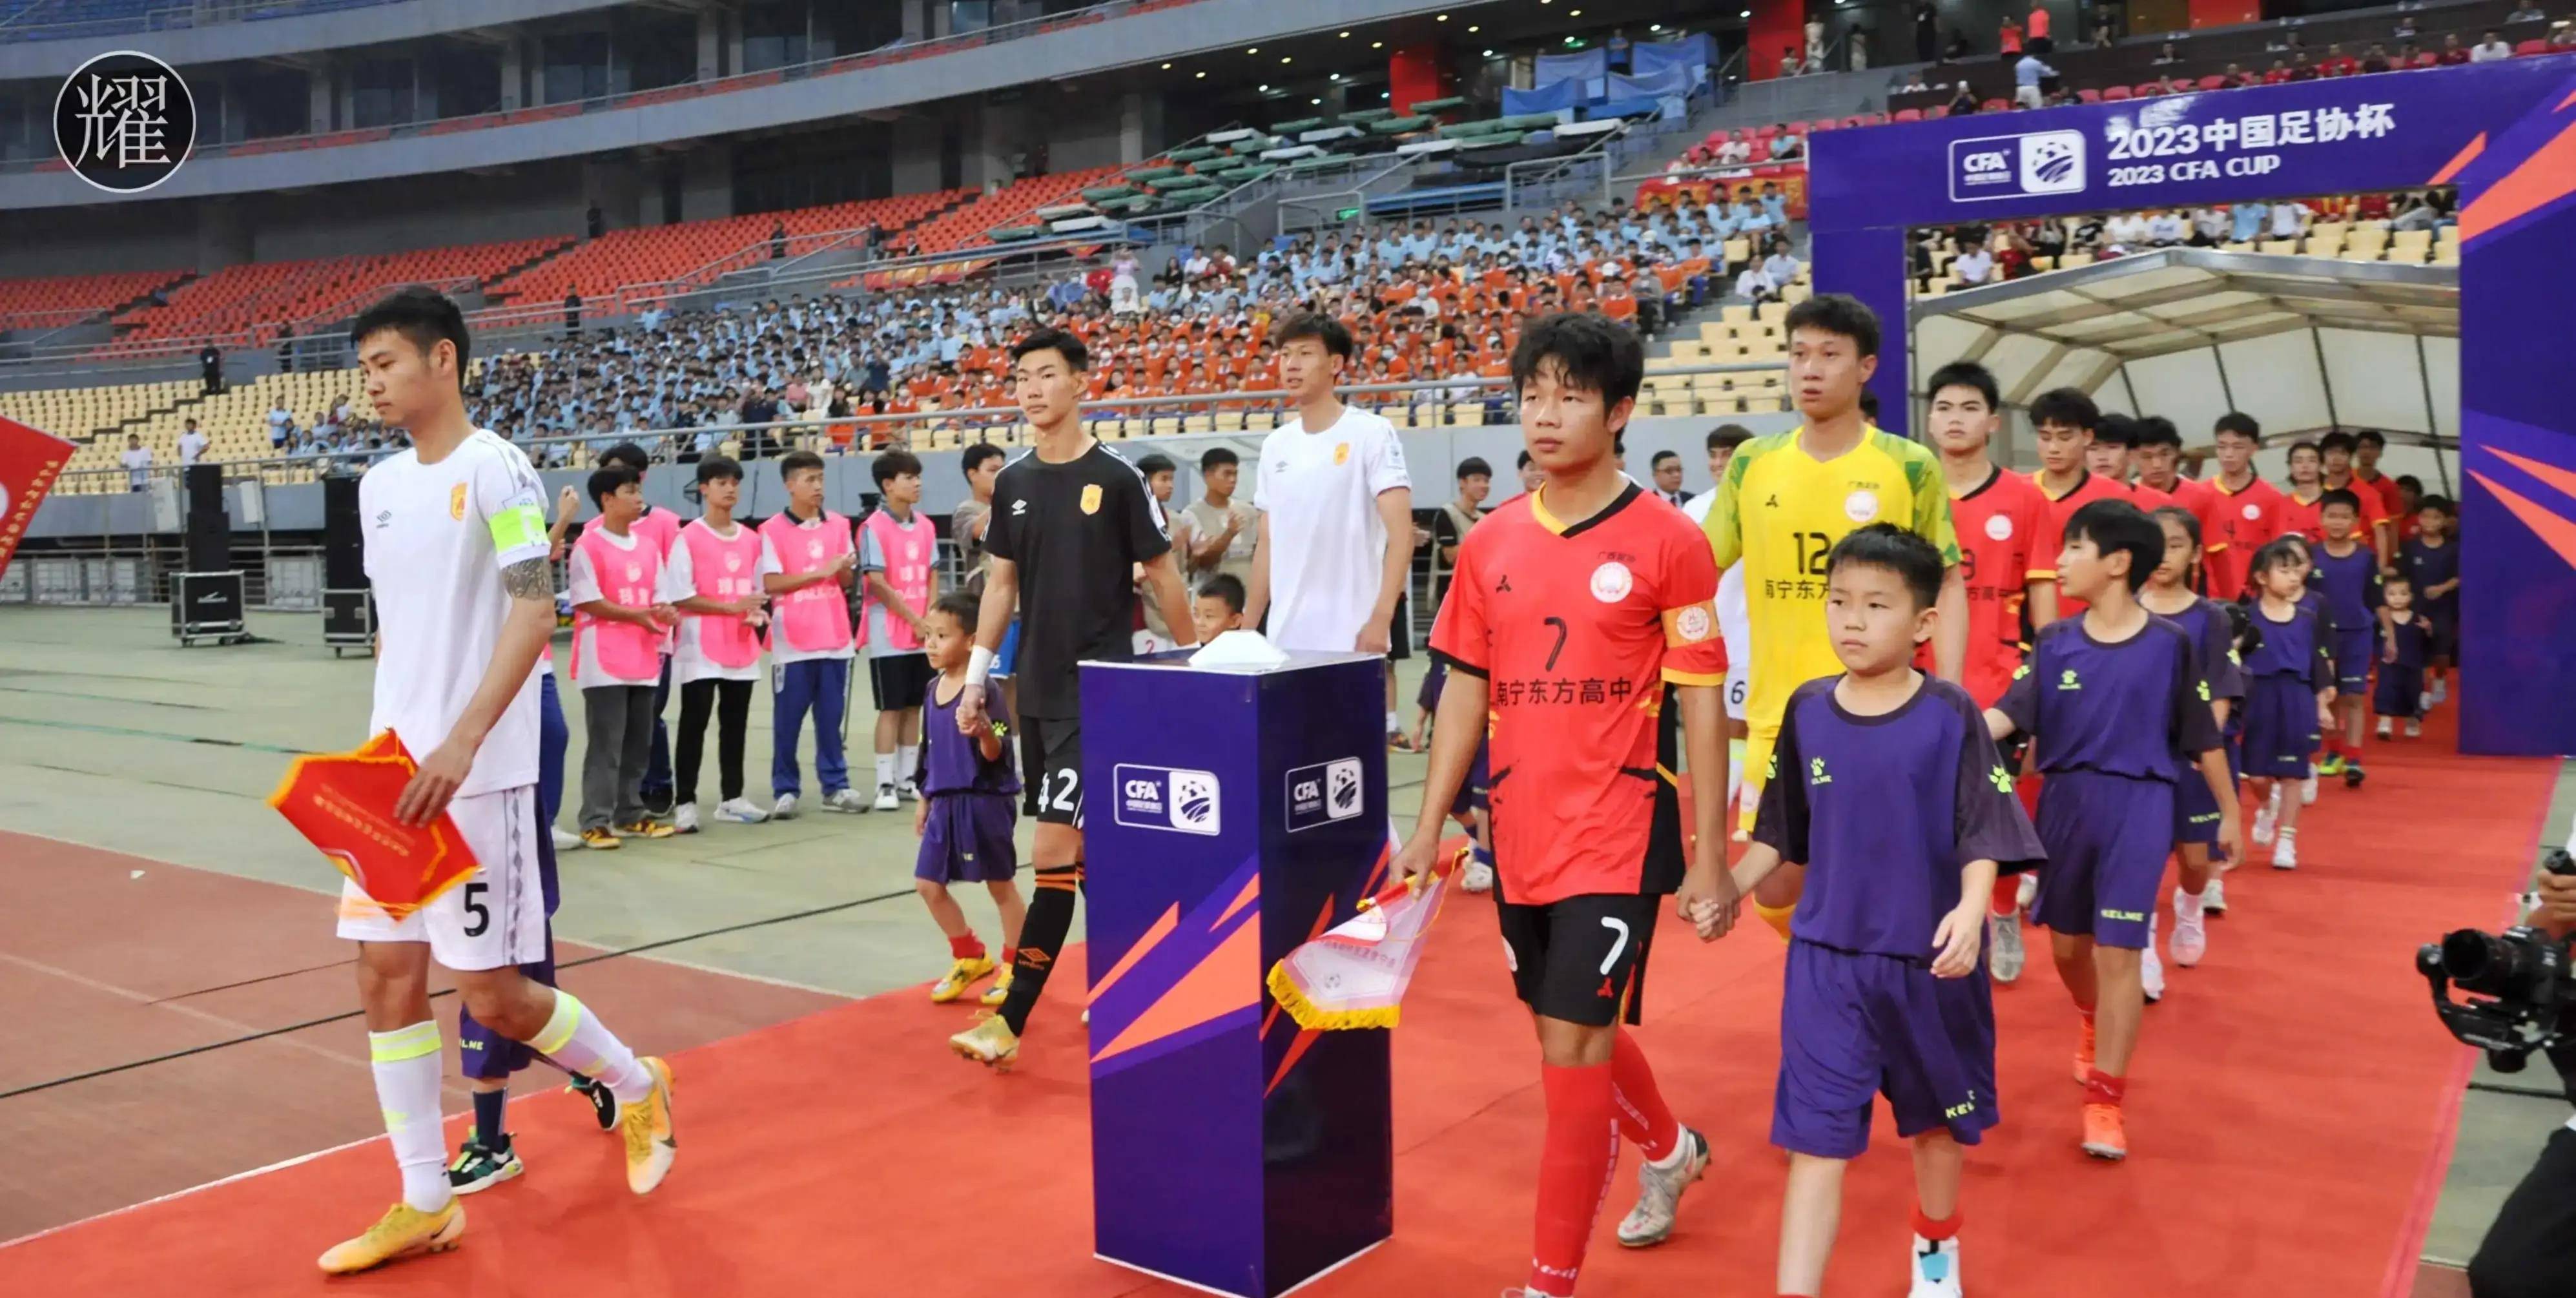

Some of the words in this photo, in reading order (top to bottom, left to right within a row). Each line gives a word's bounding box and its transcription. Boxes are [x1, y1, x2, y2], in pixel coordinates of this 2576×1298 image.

[2107, 103, 2395, 160] 2023中国足协杯
[1963, 152, 2007, 172] CFA
[2108, 165, 2165, 187] 2023
[2169, 160, 2220, 181] CFA
[2225, 154, 2281, 177] CUP
[1793, 532, 1832, 575] 12
[1543, 616, 1567, 672] 7
[1496, 677, 1633, 706] 南宁东方高中
[1731, 680, 1746, 705] 6
[1037, 768, 1078, 812] 42
[1124, 779, 1159, 801] CFA
[1293, 780, 1320, 801] CFA
[464, 881, 489, 937] 5
[1600, 916, 1629, 976] 7
